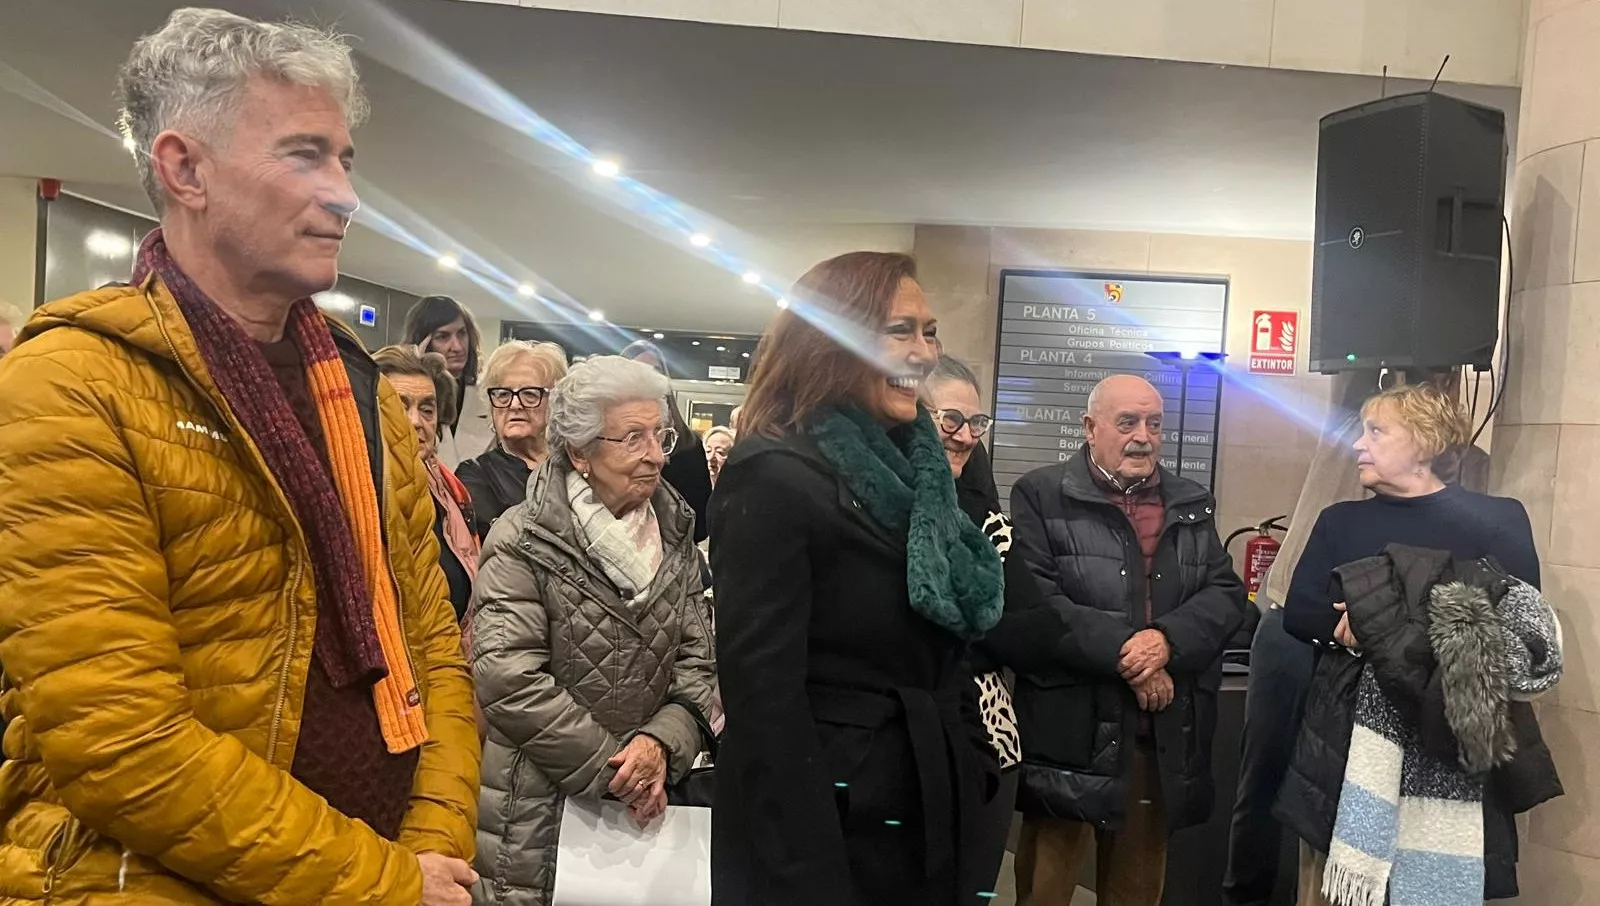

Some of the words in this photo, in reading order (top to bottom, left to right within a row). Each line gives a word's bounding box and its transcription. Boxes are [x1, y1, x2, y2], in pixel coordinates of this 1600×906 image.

[1023, 305, 1079, 319] PLANTA
[1086, 308, 1097, 321] 5
[1068, 325, 1104, 336] Oficina
[1066, 338, 1105, 349] Grupos
[1020, 349, 1076, 363] PLANTA
[1083, 352, 1093, 364] 4
[1251, 358, 1293, 370] EXTINTOR
[1016, 406, 1071, 421] PLANTA
[1170, 431, 1209, 443] Gneral
[1160, 459, 1207, 470] Amiente
